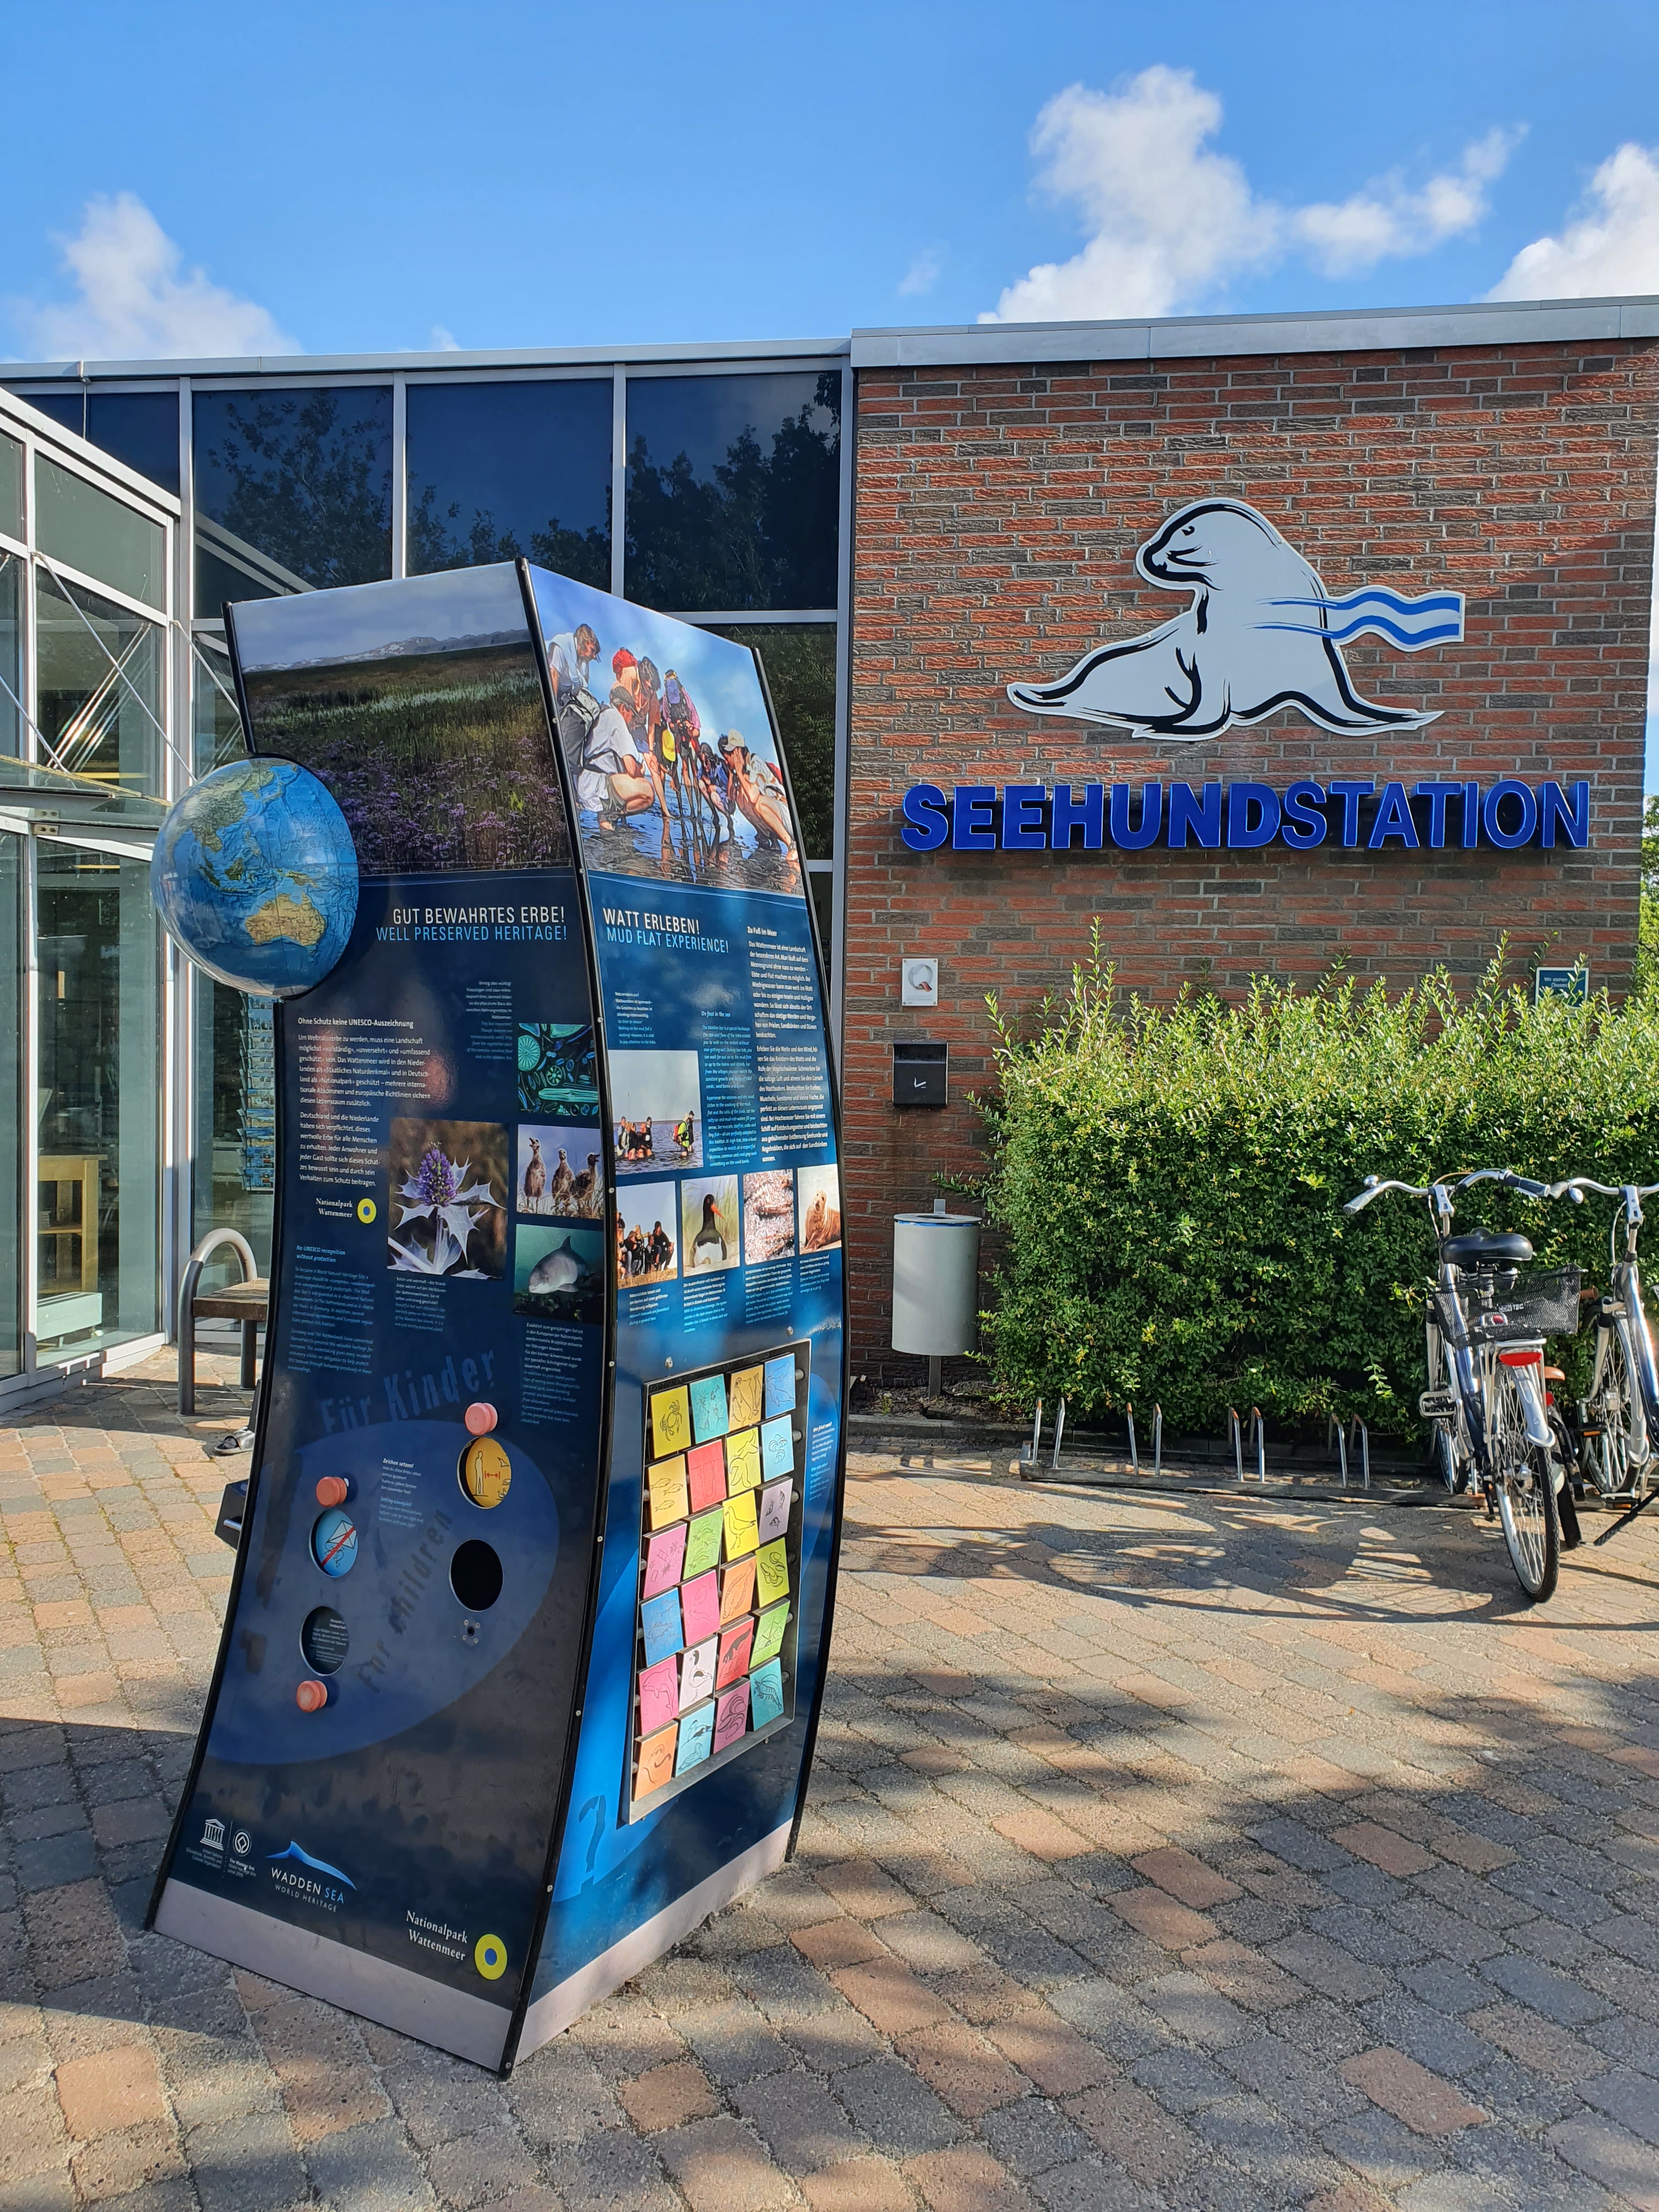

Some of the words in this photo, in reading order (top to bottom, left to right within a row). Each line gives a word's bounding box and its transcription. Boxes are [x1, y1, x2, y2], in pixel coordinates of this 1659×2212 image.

[901, 780, 1591, 851] SEEHUNDSTATION
[393, 907, 419, 924] GUT
[425, 907, 515, 924] BEWAHRTES
[521, 906, 565, 923] ERBE!
[603, 907, 640, 928] WATT
[644, 913, 700, 935] ERLEBEN!
[376, 927, 410, 941] WELL
[415, 926, 489, 941] PRESERVED
[495, 926, 568, 941] HERITAGE!
[607, 927, 633, 944] MUD
[637, 930, 662, 947] FLAT
[666, 934, 729, 953] EXPERIENCE!
[348, 1019, 414, 1029] UNESCO-Auszeichnung
[355, 1089, 384, 1097] europäische
[356, 1078, 380, 1086] geschützt
[352, 1179, 376, 1187] beitragen.
[316, 1198, 353, 1209] Nationalpark
[318, 1208, 353, 1218] Wattenmeer
[320, 1396, 371, 1434] Für
[384, 1350, 495, 1421] Kinder
[272, 1867, 322, 1895] WADDEN
[324, 1887, 345, 1904] SEA
[274, 1884, 300, 1899] WORLD
[302, 1894, 337, 1912] HERITAGE
[406, 1910, 469, 1944] Nationalpark
[408, 1929, 466, 1961] Wattenmeer
